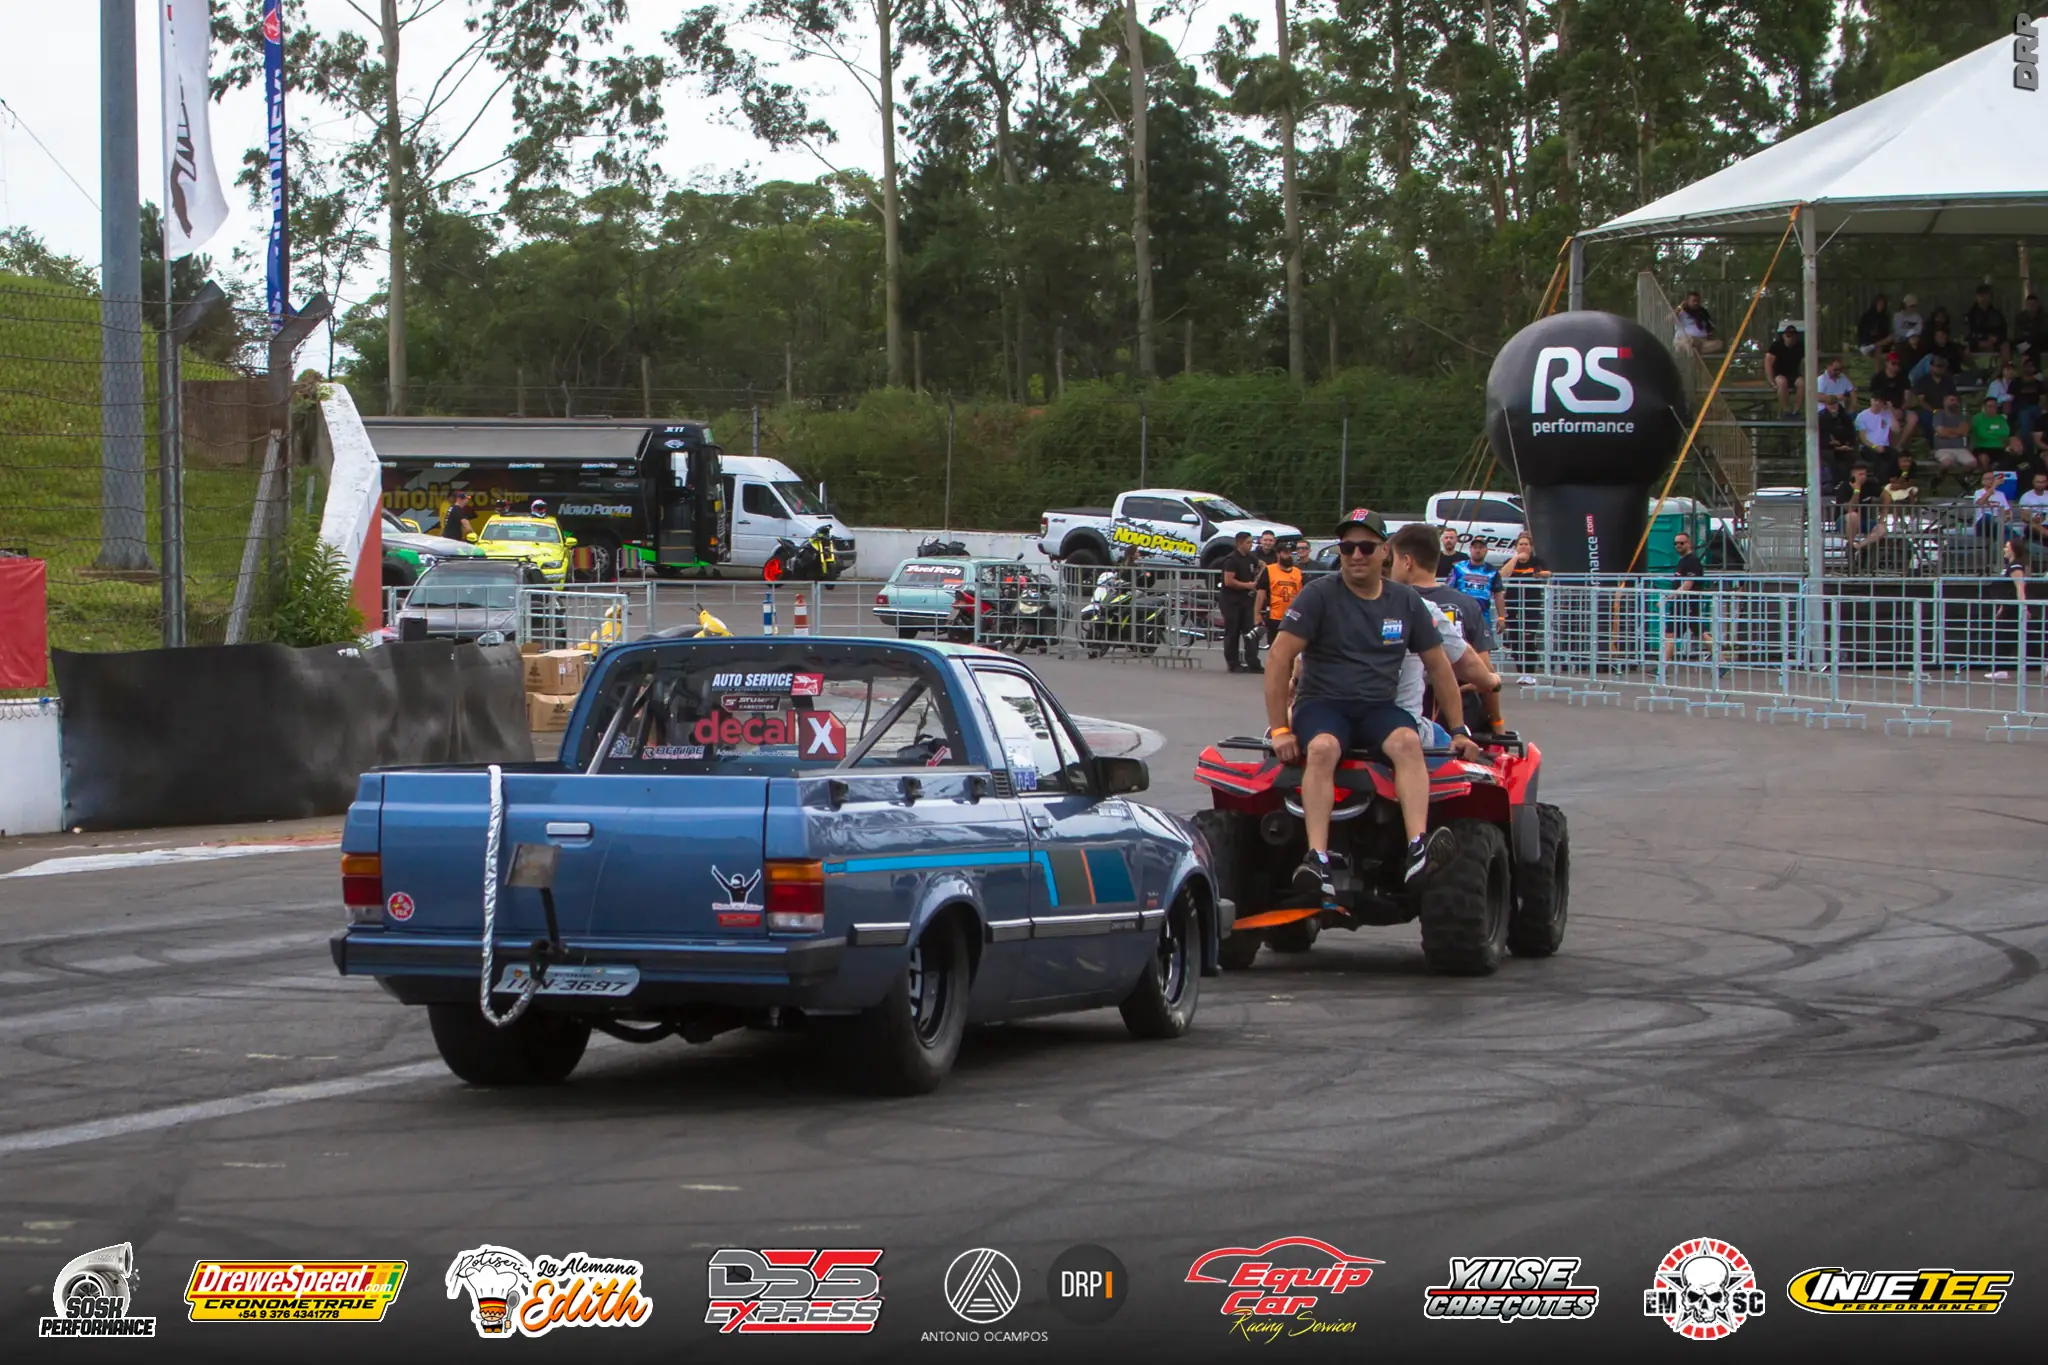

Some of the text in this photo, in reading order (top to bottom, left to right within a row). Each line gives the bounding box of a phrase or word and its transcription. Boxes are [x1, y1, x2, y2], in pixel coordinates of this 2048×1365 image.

[1531, 346, 1634, 414] RS
[1532, 418, 1635, 437] performance
[712, 673, 794, 687] AUTO SERVICE
[694, 710, 796, 745] decal
